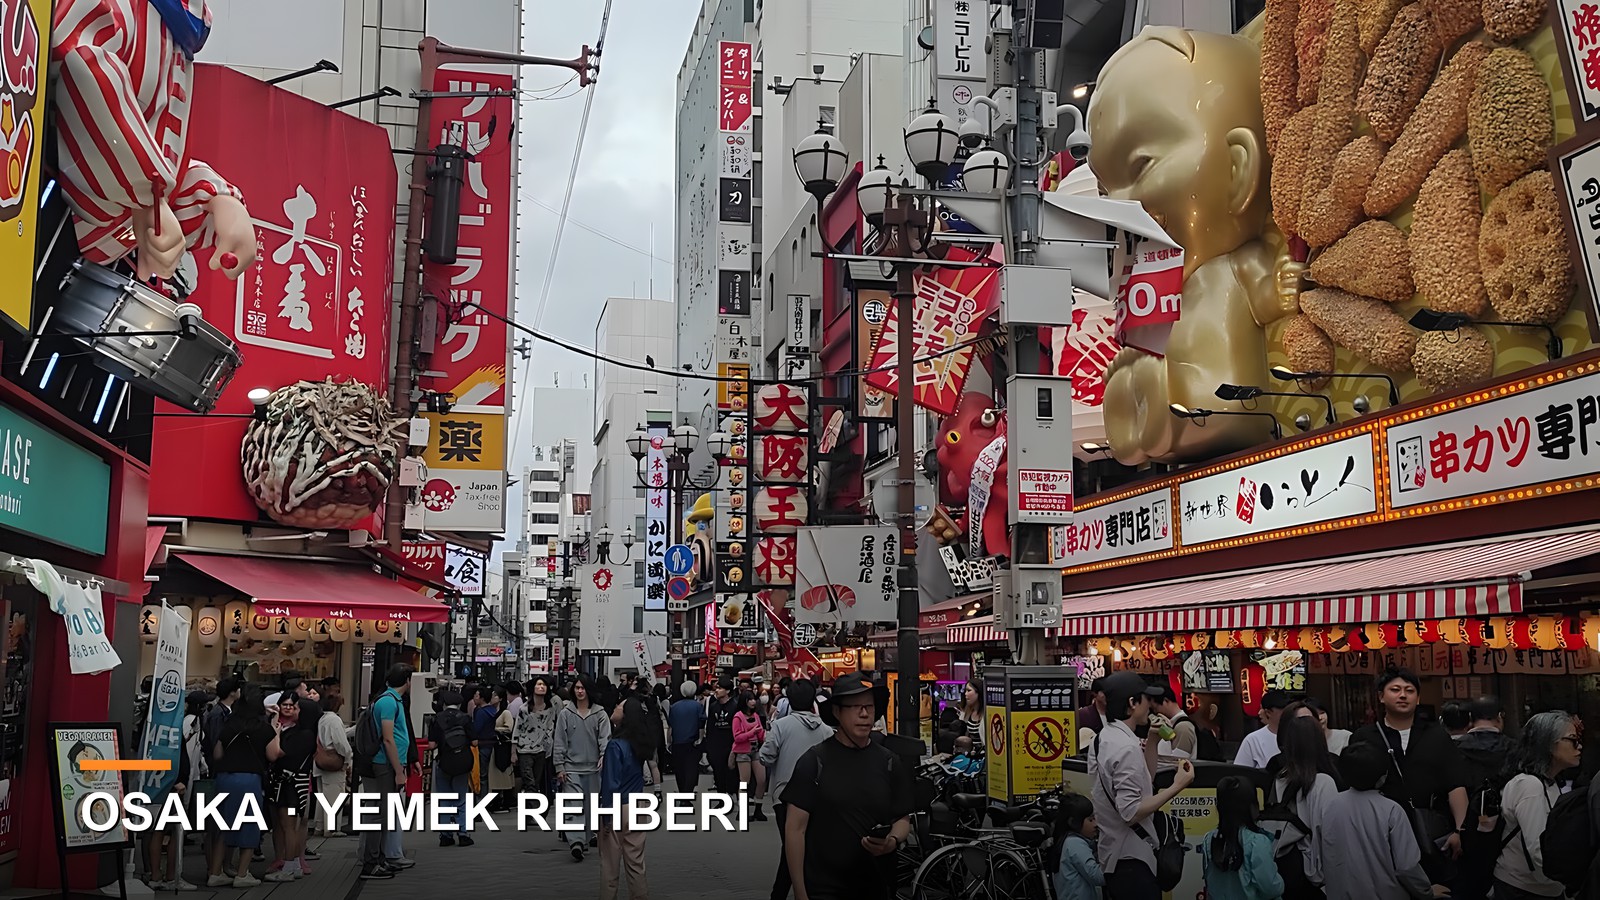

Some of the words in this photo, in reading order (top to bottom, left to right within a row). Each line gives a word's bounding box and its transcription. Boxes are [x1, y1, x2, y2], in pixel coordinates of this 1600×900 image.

[439, 420, 483, 462] 薬
[0, 429, 32, 484] ASE
[754, 383, 809, 585] 大阪王将
[1021, 472, 1069, 482] 防犯監視カメラ
[1035, 483, 1057, 492] 作動中
[465, 492, 500, 501] Tax-free
[477, 503, 500, 511] Shop
[1184, 494, 1231, 523] 新世界
[1066, 506, 1151, 556] 串カツ専門店
[402, 545, 443, 559] ツルハ
[58, 731, 85, 741] VEGAN
[85, 732, 113, 741] RAMEN
